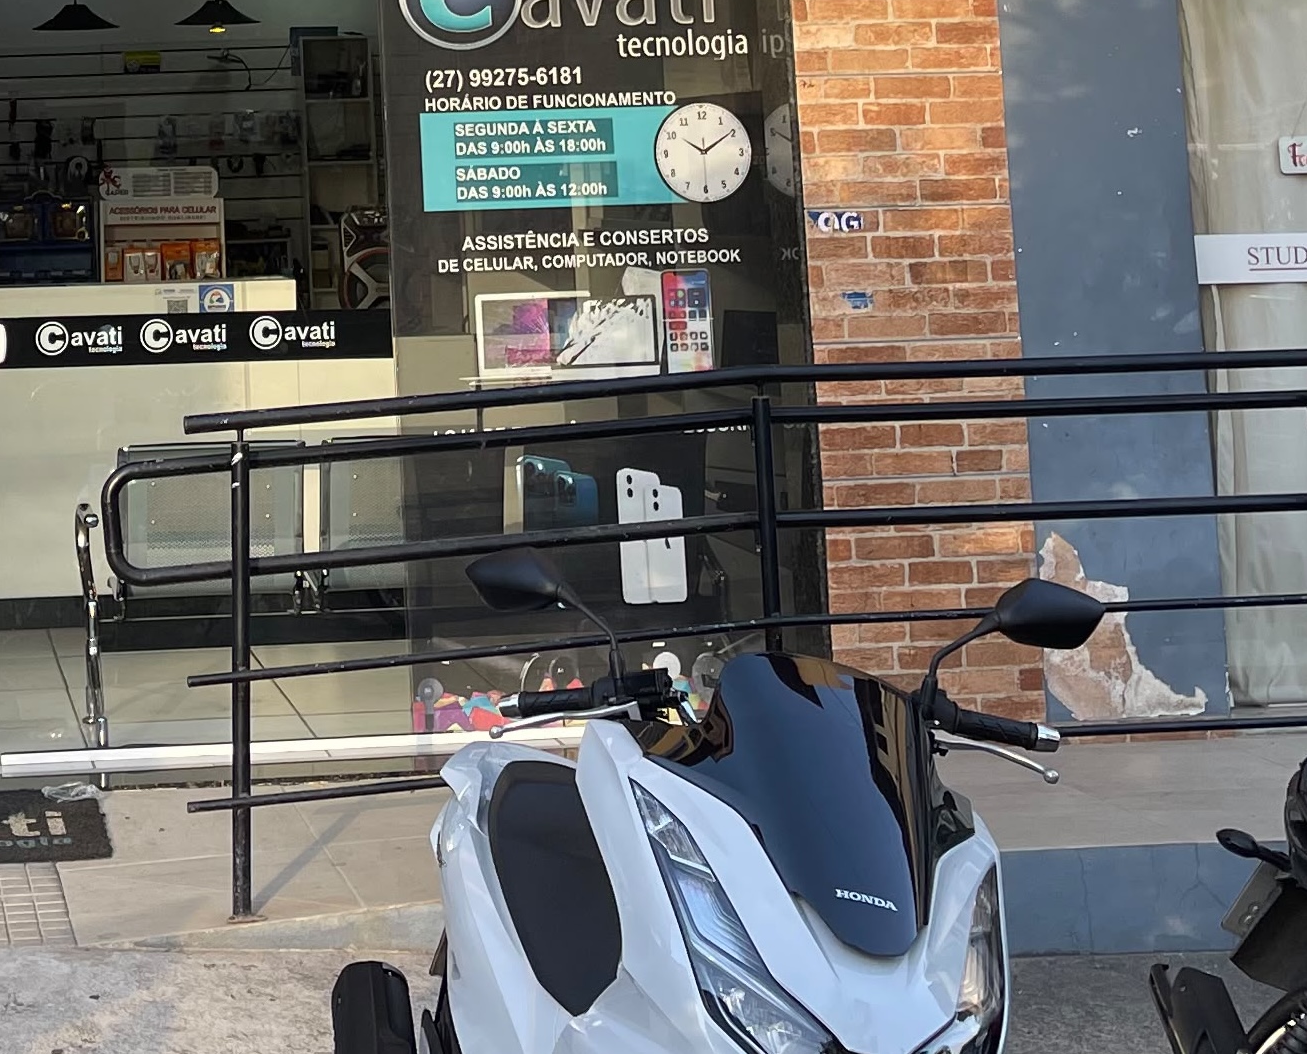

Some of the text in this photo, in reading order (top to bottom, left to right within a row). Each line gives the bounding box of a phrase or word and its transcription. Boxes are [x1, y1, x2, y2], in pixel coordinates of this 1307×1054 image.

[616, 29, 749, 61] tecnologia
[425, 66, 583, 92] (27) 99275-6181
[424, 91, 677, 112] HORÁRIO DE FUNCIONAMENTO
[679, 117, 689, 126] 11
[697, 111, 707, 120] 12
[718, 116, 723, 126] 1
[455, 121, 530, 137] SEGUNDA
[547, 120, 597, 134] SEXTA
[730, 128, 736, 138] 2
[666, 131, 677, 140] 10
[456, 137, 606, 156] DAS 9:00h ÀS 18:00h
[738, 147, 744, 157] 3
[663, 149, 669, 159] 9
[456, 164, 521, 181] SÁBADO
[670, 168, 676, 178] 8
[733, 167, 740, 176] 4
[457, 181, 608, 200] DAS 9:00h ÀS 12:00h
[684, 181, 691, 190] 7
[703, 184, 709, 194] 6
[721, 180, 727, 189] 5
[159, 206, 181, 214] PARA
[182, 205, 217, 214] CELULAR
[461, 228, 709, 252] ASSISTÊNCIA E CONSERTOS
[438, 248, 742, 273] DE CELULAR, COMPUTADOR, NOTEBOOK
[35, 321, 123, 356] Cavati
[140, 318, 227, 353] Cavati
[249, 315, 336, 350] Cavati
[835, 888, 899, 912] HONDA
